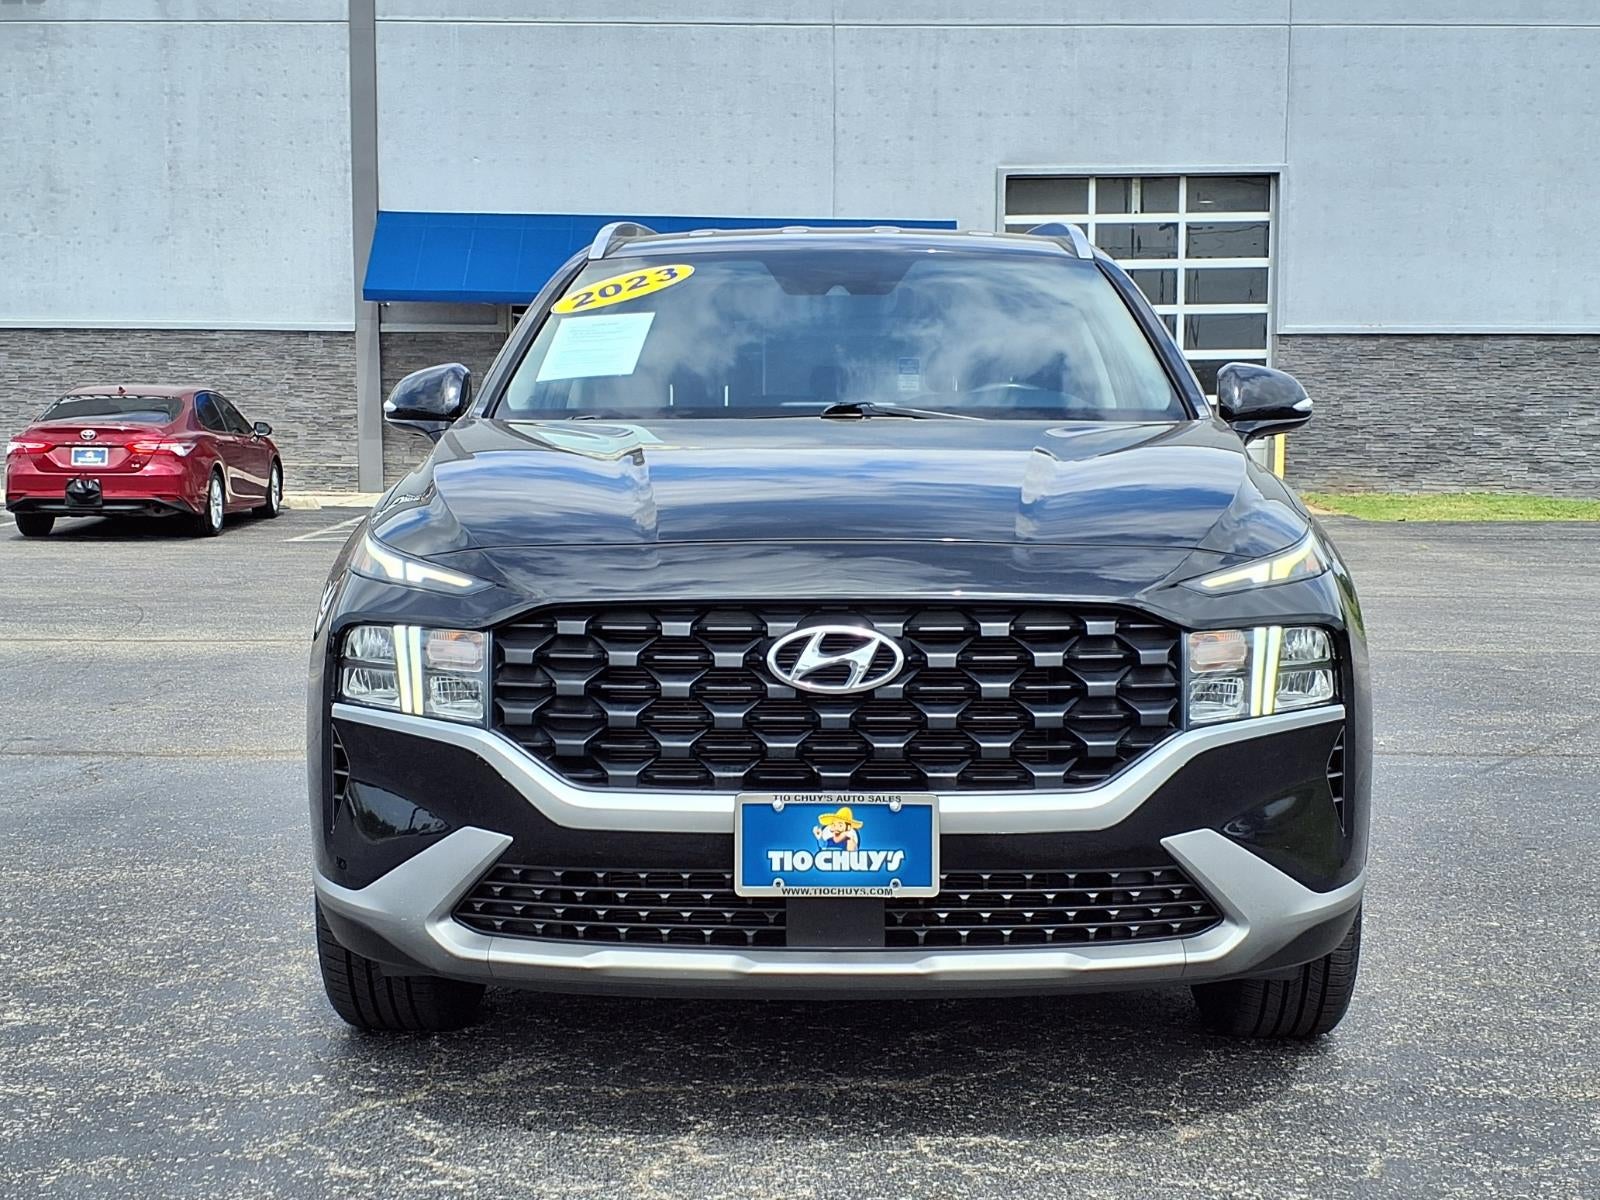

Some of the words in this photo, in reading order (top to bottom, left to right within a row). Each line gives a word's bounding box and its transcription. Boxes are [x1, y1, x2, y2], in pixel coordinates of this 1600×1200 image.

[571, 267, 678, 310] 2023
[773, 794, 791, 802] TIO
[794, 794, 833, 802] CHUY'S
[836, 795, 865, 803] AUTO
[867, 795, 902, 803] SALES
[781, 887, 893, 896] WWW.TIOCHUYS.COM
